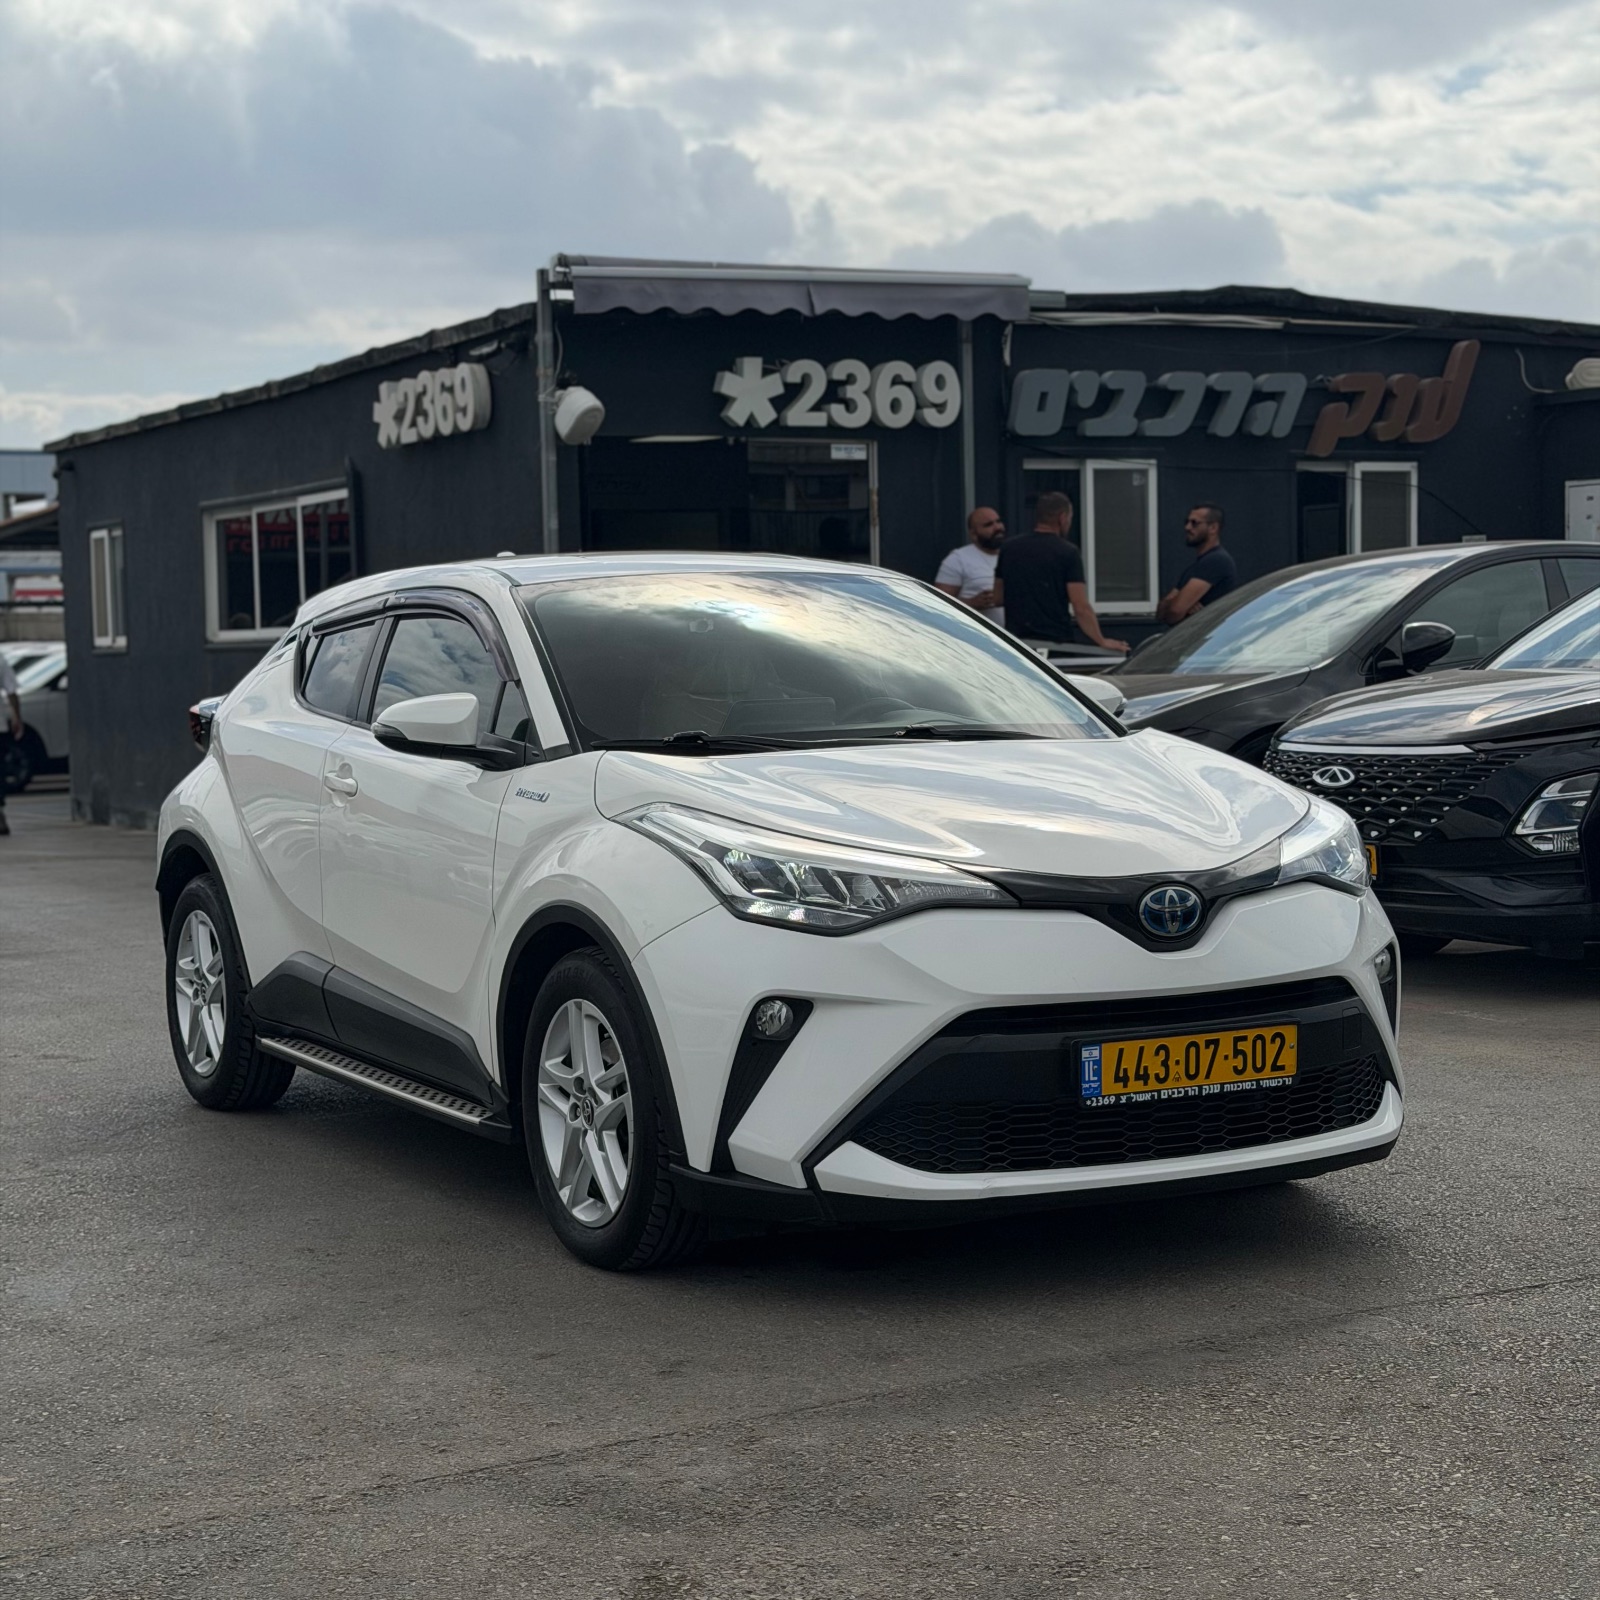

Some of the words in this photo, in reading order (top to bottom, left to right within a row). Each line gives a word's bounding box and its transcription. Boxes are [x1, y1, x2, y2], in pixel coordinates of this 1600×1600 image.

[1010, 368, 1307, 438] הרכבים
[1307, 339, 1480, 458] ענק
[1084, 1060, 1098, 1081] IL
[1223, 1081, 1257, 1092] בסוכנות
[1259, 1077, 1293, 1088] נרכשתי
[1161, 1086, 1198, 1099] הרכבים
[1202, 1083, 1221, 1096] ענק
